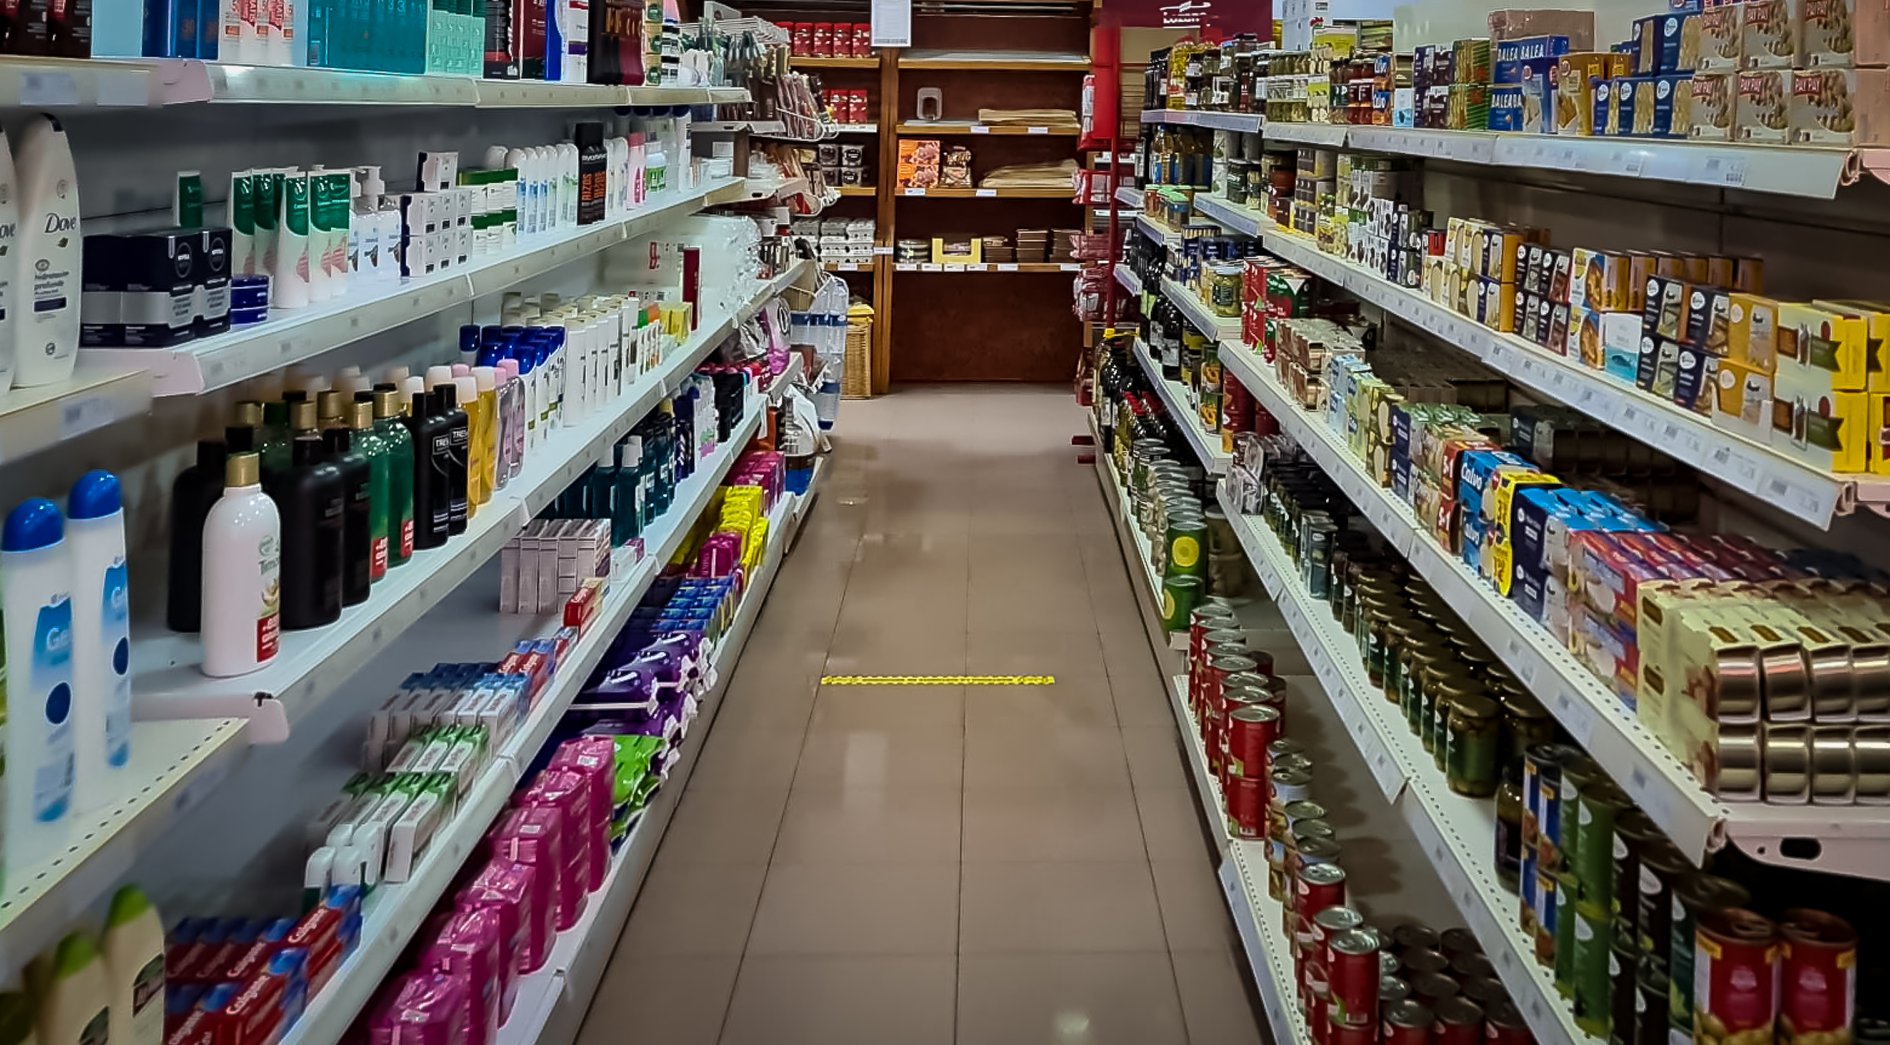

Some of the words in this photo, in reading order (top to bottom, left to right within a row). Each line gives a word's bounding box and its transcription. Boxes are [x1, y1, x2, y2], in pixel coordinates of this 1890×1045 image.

[1746, 8, 1757, 22] PAY
[1757, 6, 1769, 21] PAY
[1693, 81, 1703, 95] PAY
[1703, 81, 1712, 95] PAY
[1740, 78, 1750, 93] PAY
[1750, 78, 1762, 93] PAY
[1795, 78, 1807, 92] PAY
[1807, 78, 1820, 92] PAY
[582, 173, 592, 201] RIZOS
[0, 223, 16, 238] ove
[45, 212, 78, 233] Dove
[1461, 462, 1482, 491] Calvo
[1464, 519, 1480, 546] alvo
[288, 908, 329, 944] Colgate
[226, 941, 267, 978] Colgate
[226, 975, 271, 1015] Colgate
[168, 1009, 206, 1045] olgate
